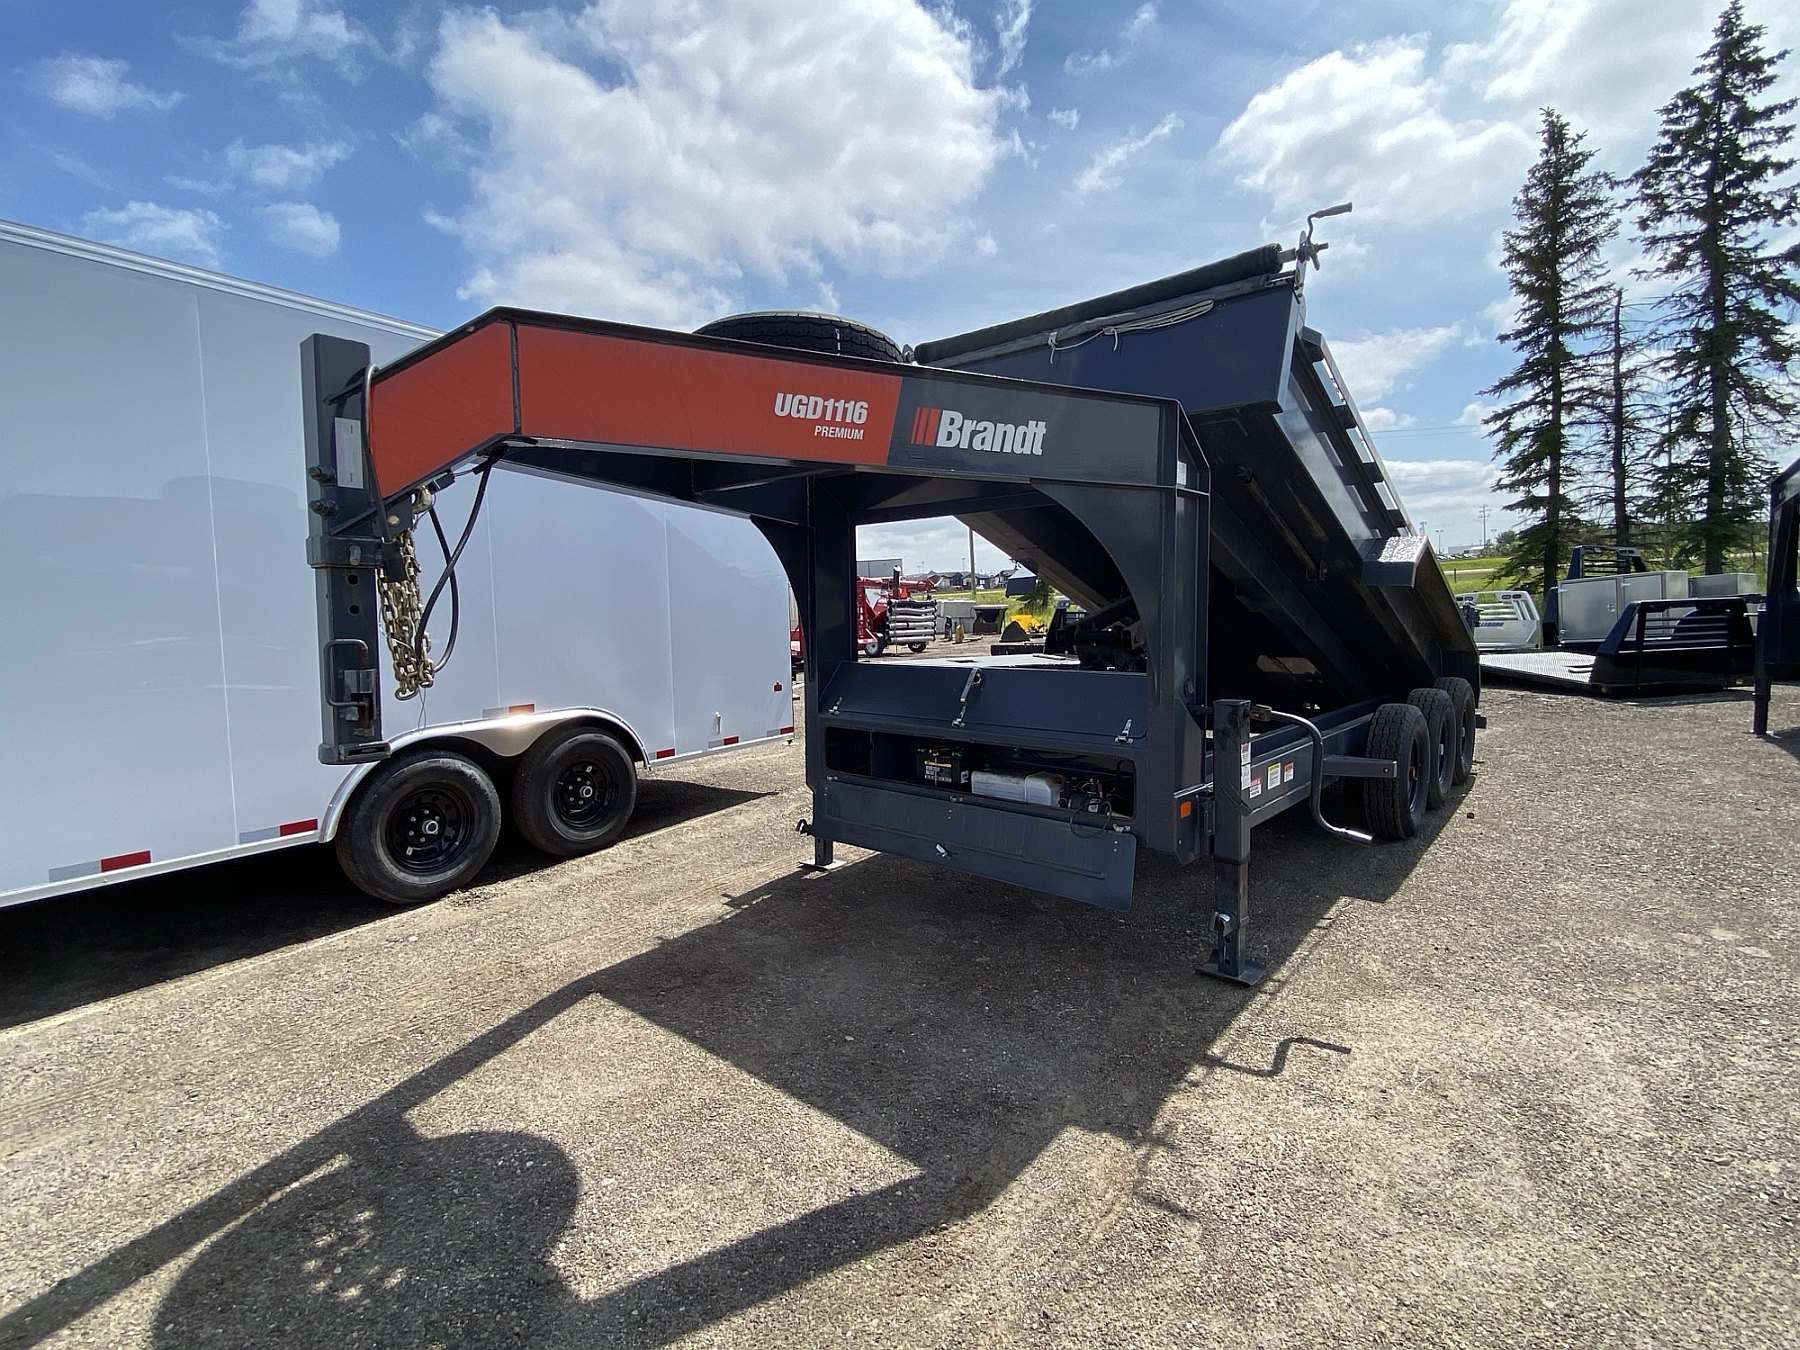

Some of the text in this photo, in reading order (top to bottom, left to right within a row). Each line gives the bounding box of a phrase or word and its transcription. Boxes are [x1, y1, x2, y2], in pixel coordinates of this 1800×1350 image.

[774, 392, 869, 424] UGD1116
[814, 425, 864, 440] PREMIUM
[936, 409, 1047, 456] Brandt
